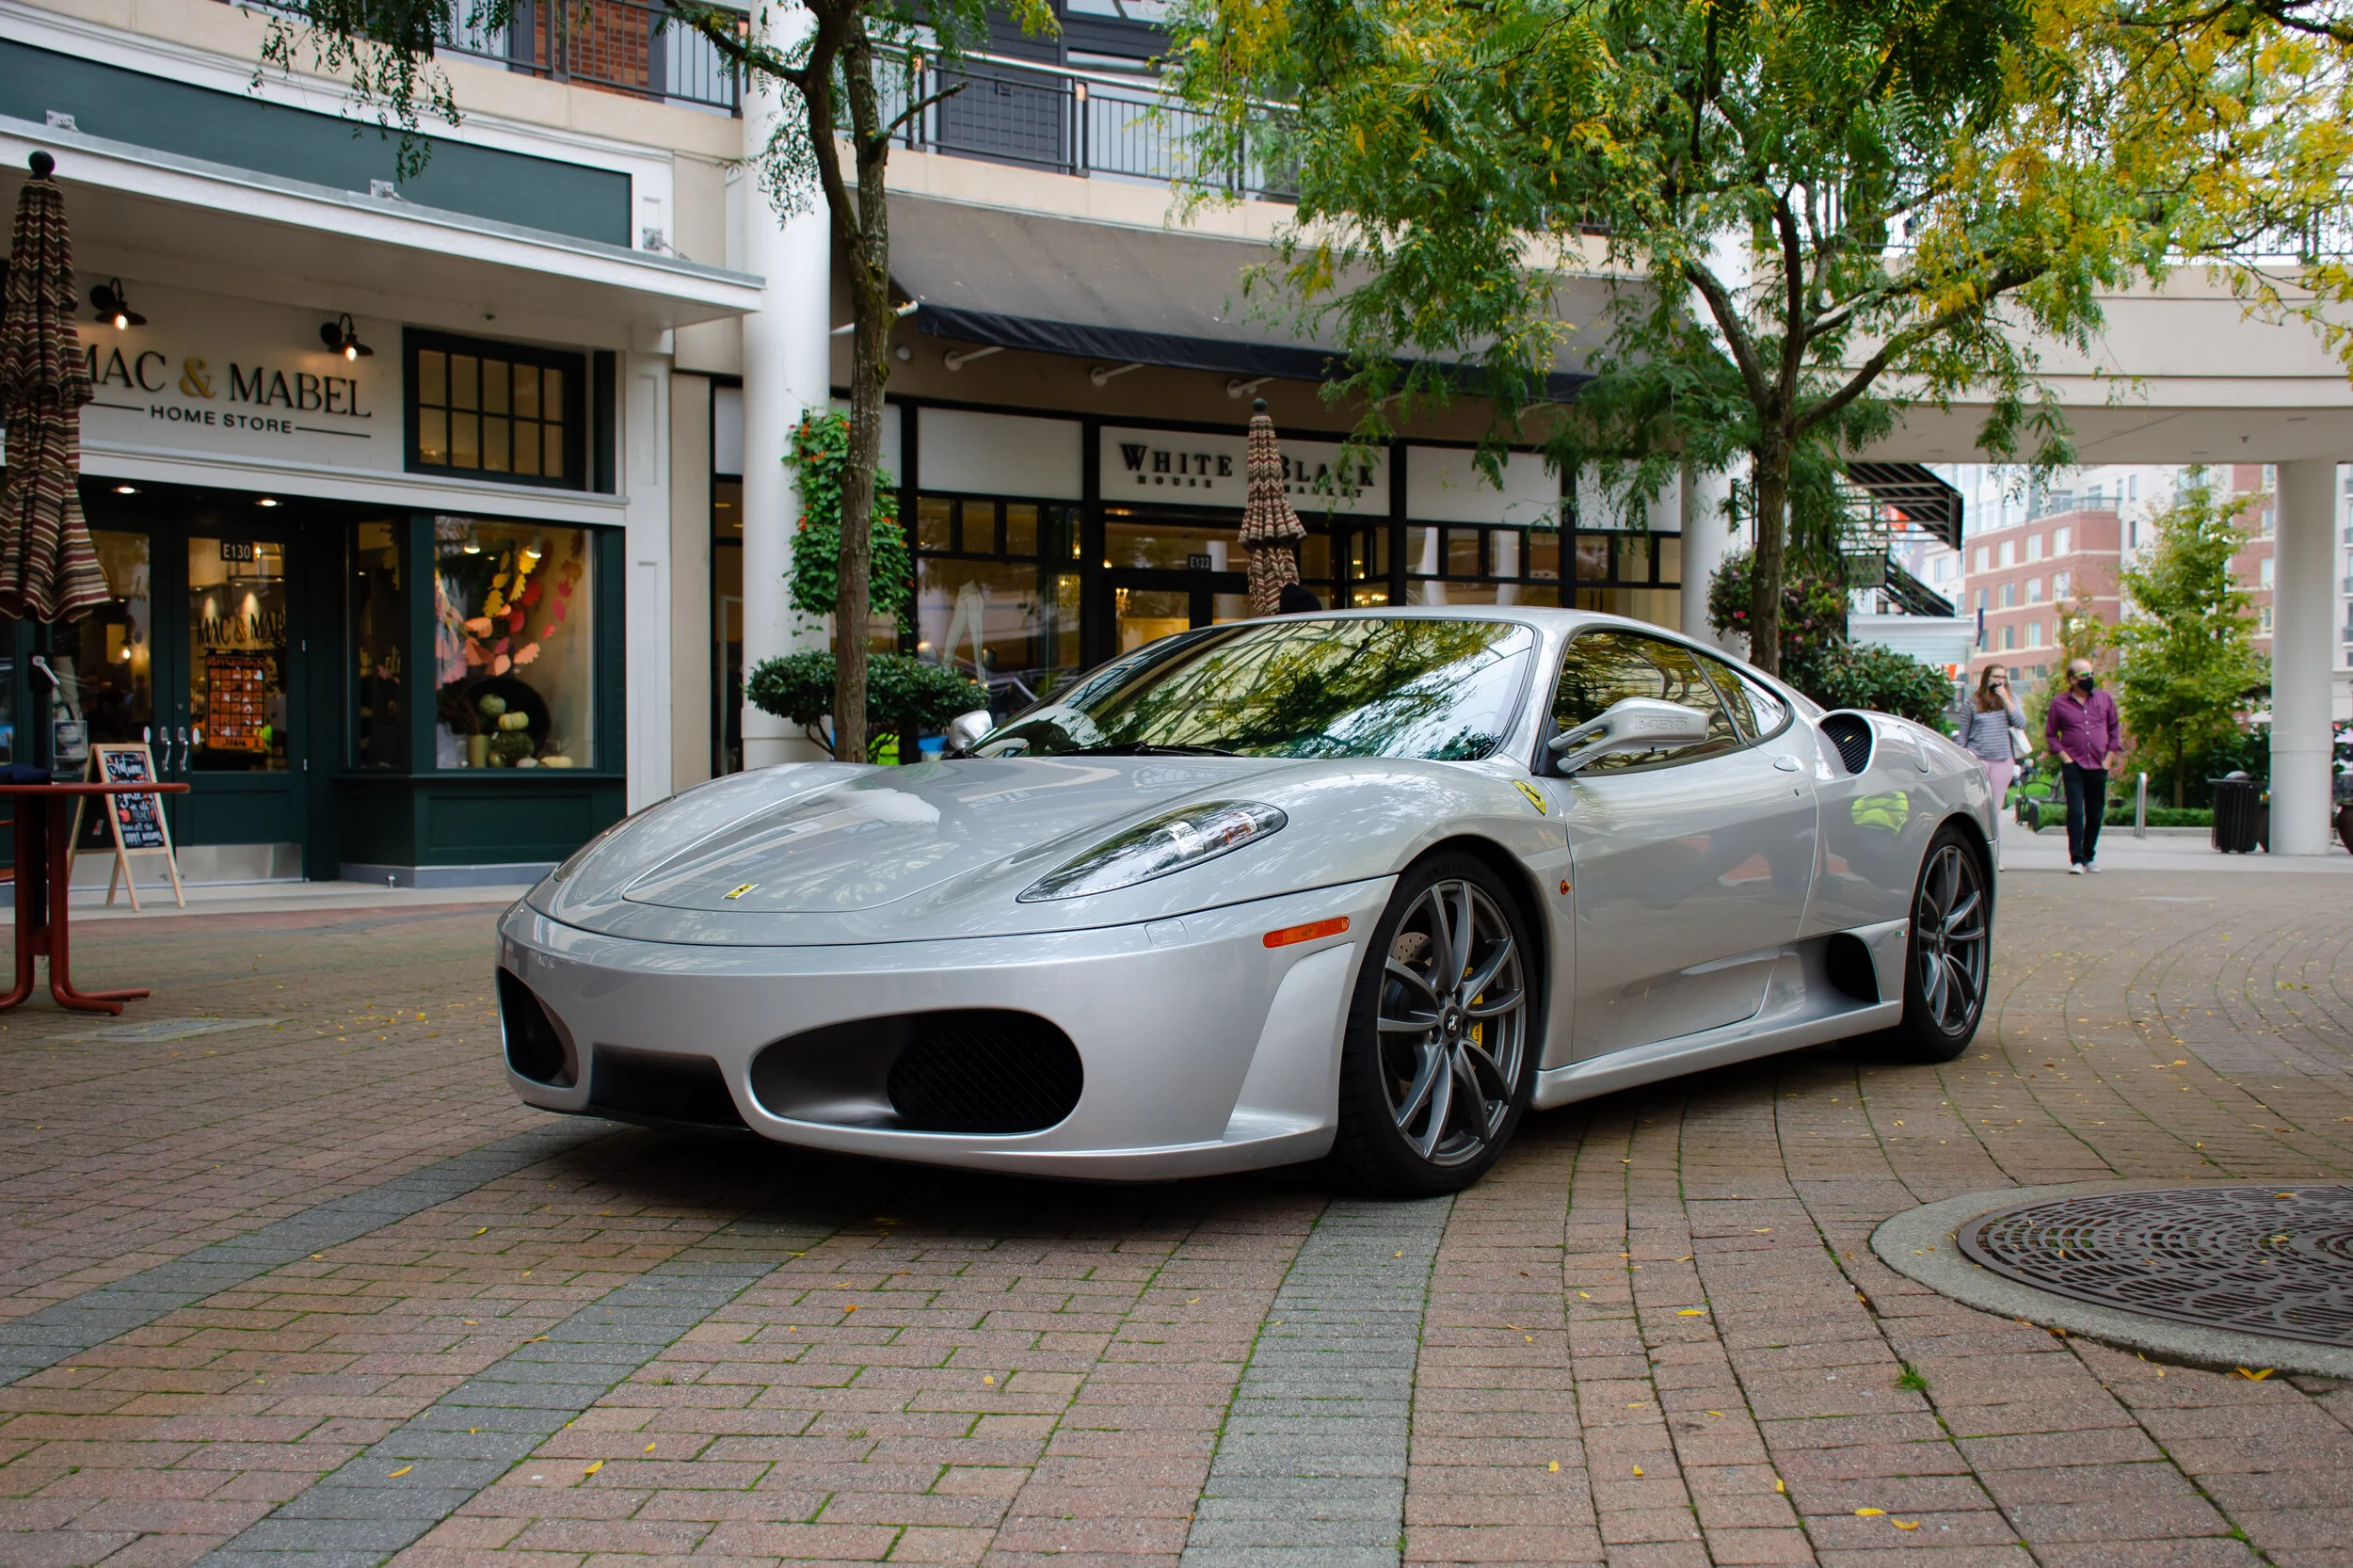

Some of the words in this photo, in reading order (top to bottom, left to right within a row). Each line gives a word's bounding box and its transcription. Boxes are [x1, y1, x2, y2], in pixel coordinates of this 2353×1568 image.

[180, 357, 216, 399] &
[229, 362, 372, 418] MABEL
[151, 405, 216, 425] HOME
[223, 413, 293, 434] STORE
[1119, 443, 1233, 477] WHITE
[1137, 474, 1212, 488] HOUSE
[223, 543, 251, 559] E130
[197, 615, 231, 645] MAC
[1634, 714, 1688, 731] F430
